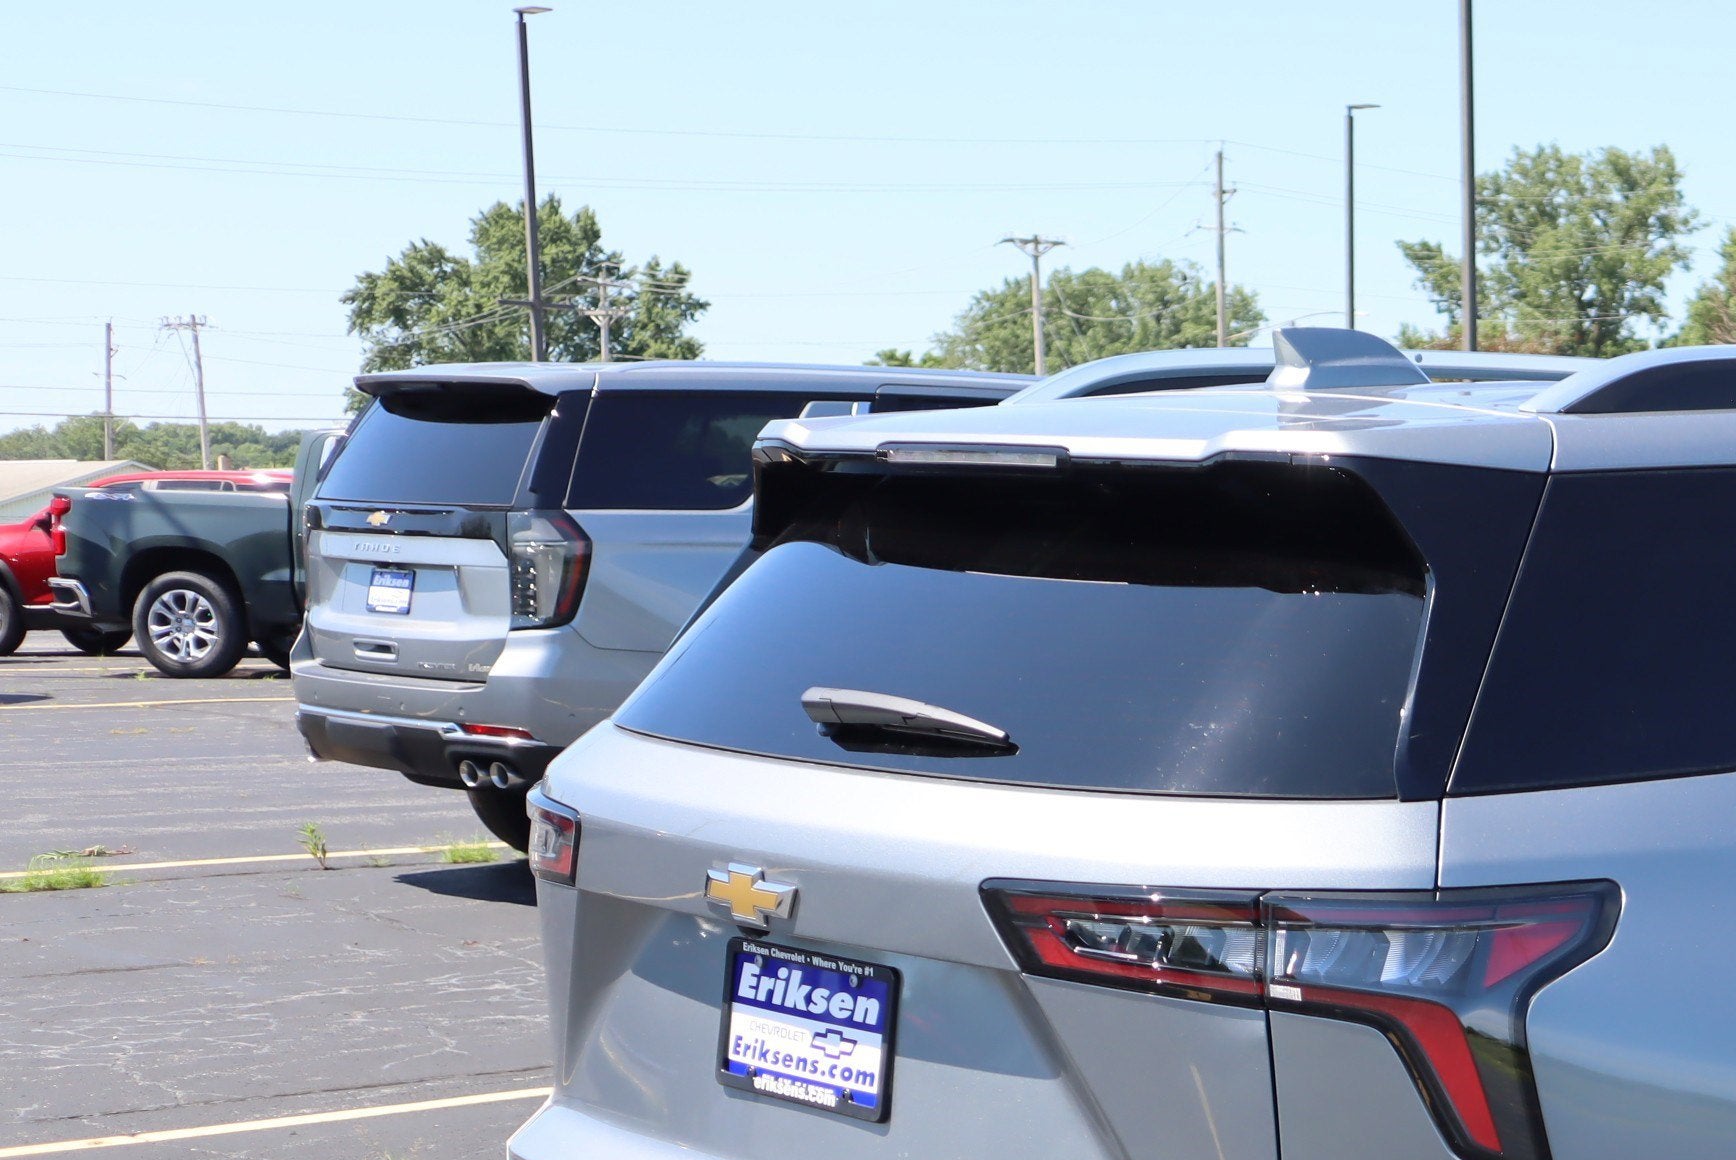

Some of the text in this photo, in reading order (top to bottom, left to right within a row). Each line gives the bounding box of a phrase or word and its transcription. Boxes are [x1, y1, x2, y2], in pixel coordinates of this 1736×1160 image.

[742, 941, 875, 977] Eriksen Chevrolet Where You're #1
[737, 961, 880, 1026] Eriksen
[750, 1020, 806, 1042] CHEVROLET
[732, 1034, 876, 1087] Eriksens.com
